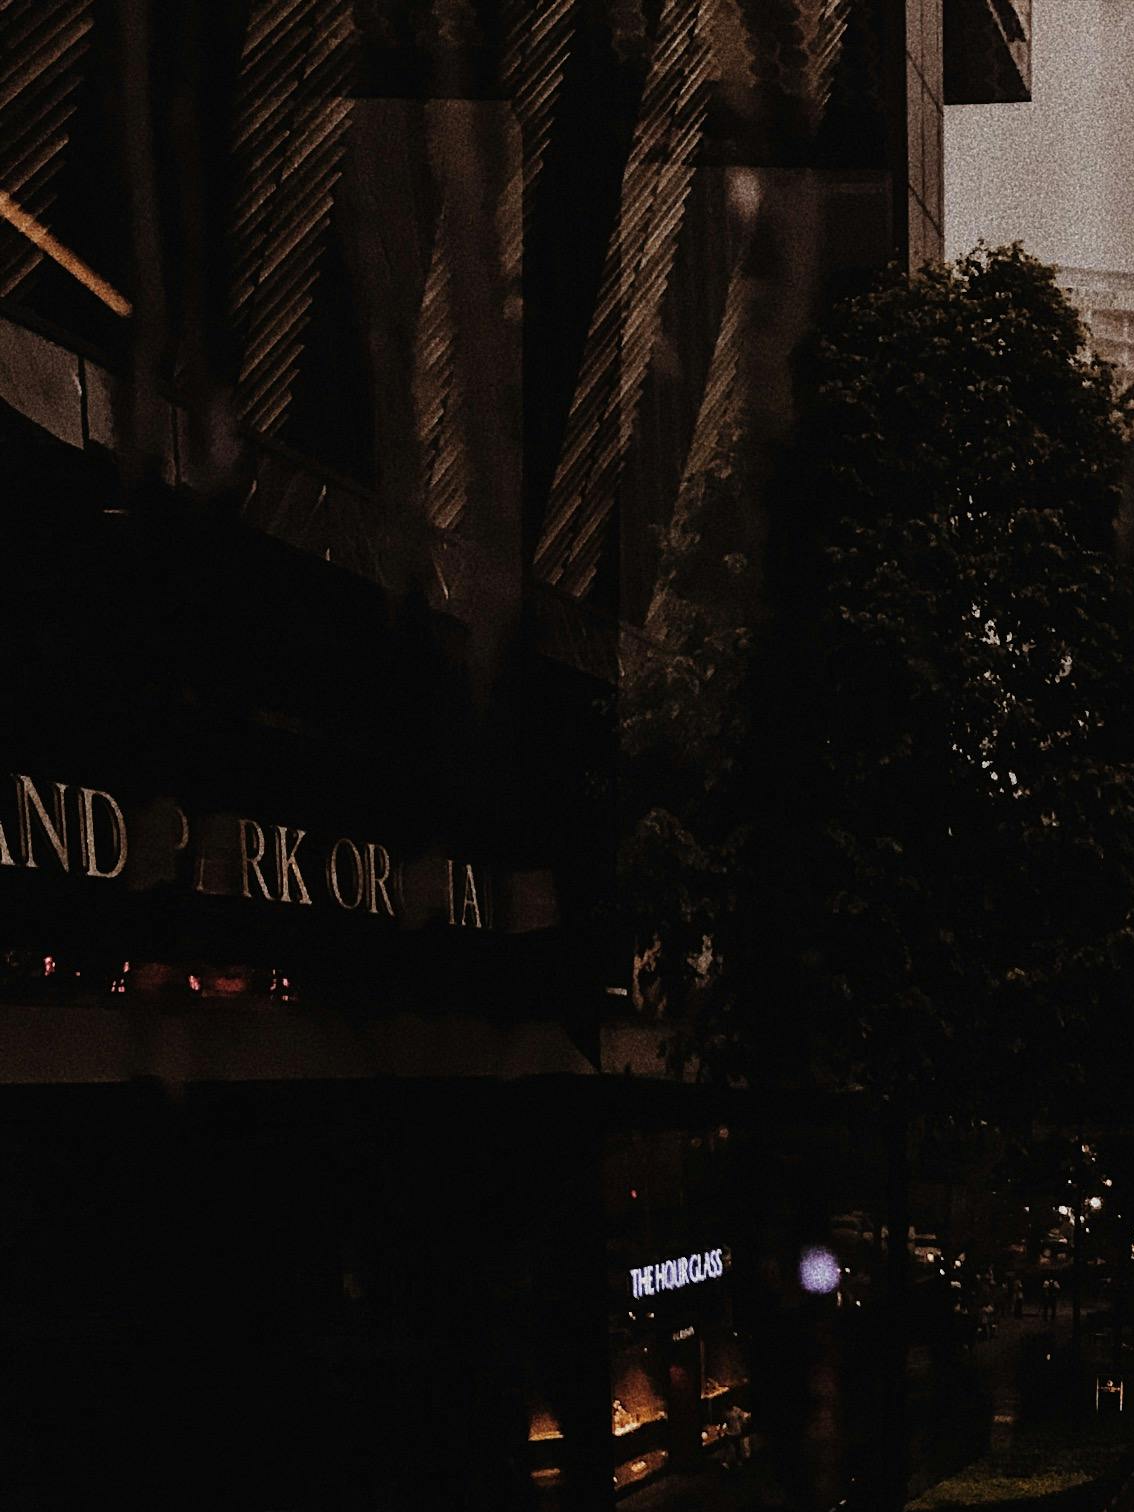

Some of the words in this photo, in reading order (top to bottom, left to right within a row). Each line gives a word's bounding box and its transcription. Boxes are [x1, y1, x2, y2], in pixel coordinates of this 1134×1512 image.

[0, 775, 129, 879] ND
[629, 1266, 656, 1300] THE
[655, 1256, 690, 1293] HOUR
[688, 1247, 724, 1283] GLASS
